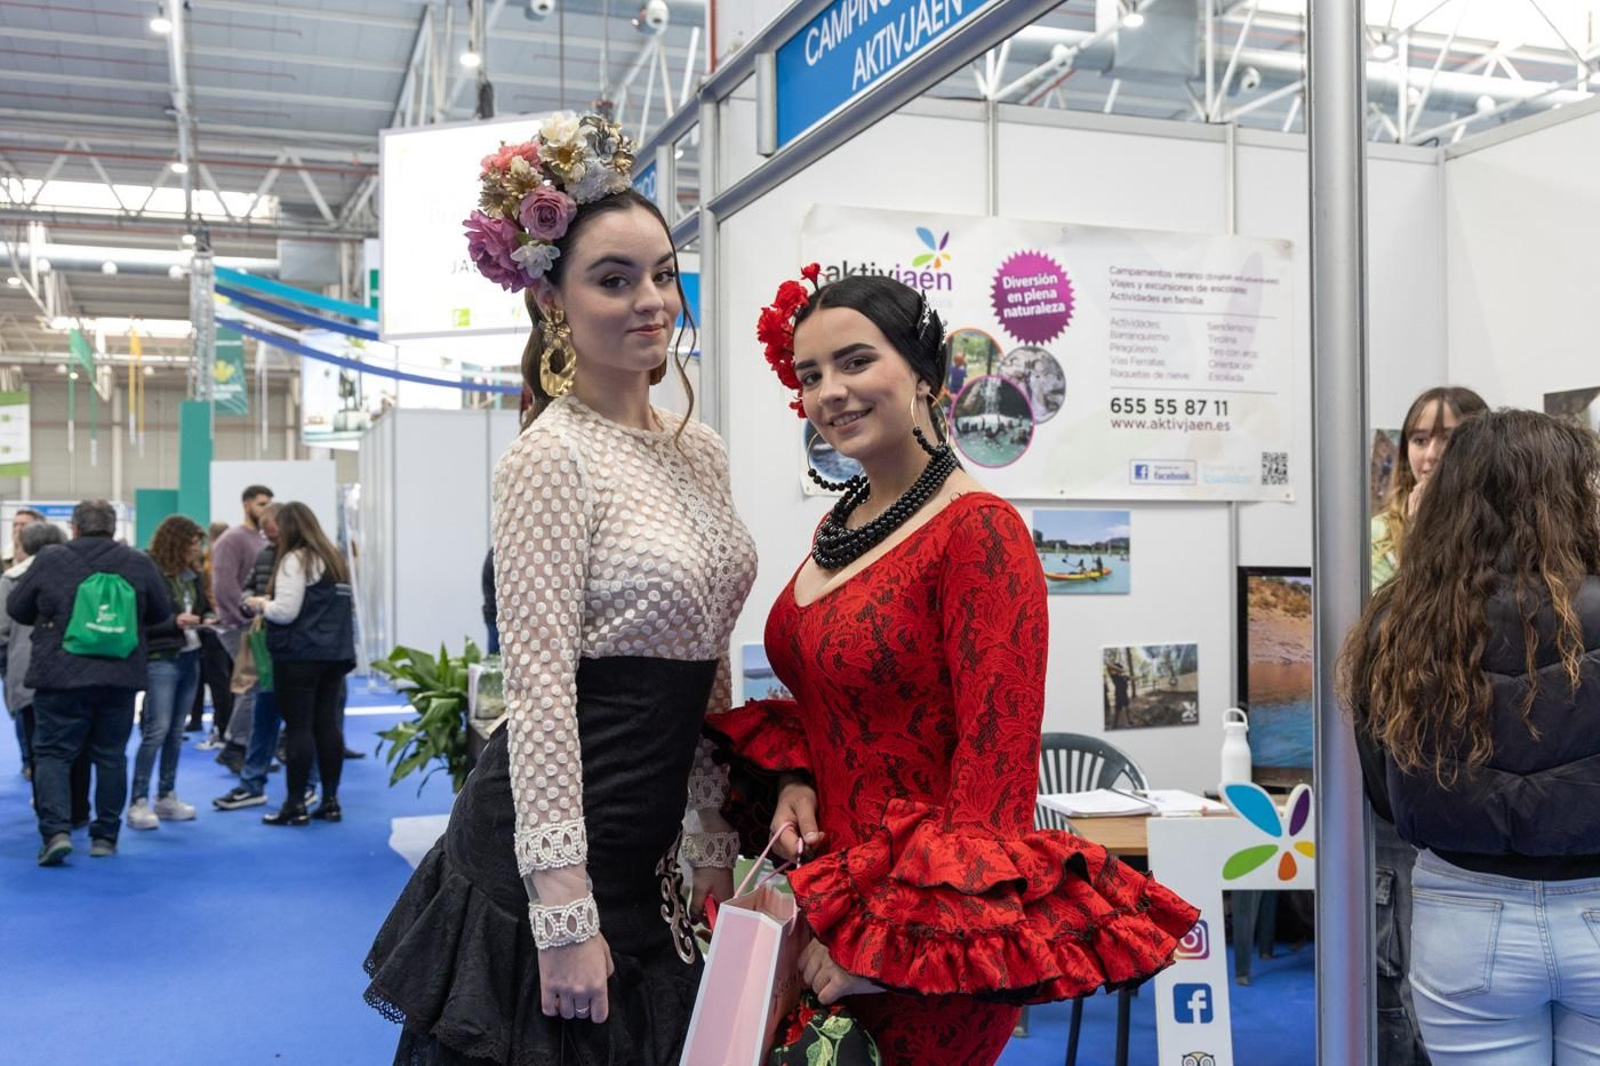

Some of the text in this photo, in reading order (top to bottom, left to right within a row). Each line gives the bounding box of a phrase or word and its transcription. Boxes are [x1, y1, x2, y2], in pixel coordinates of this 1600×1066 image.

[805, 0, 893, 66] CAMPIN
[1109, 265, 1172, 278] Campamentos
[1002, 273, 1058, 289] Diversión
[1109, 278, 1135, 290] Viajes
[1145, 282, 1194, 292] excursiones
[1196, 285, 1208, 293] de
[1007, 288, 1058, 305] en plena
[1109, 292, 1160, 303] Actividades
[1174, 295, 1204, 305] familia
[1003, 301, 1066, 318] naturaleza
[1110, 397, 1228, 416] 655 55 87 11
[1110, 418, 1231, 433] www.aktivjaen.es
